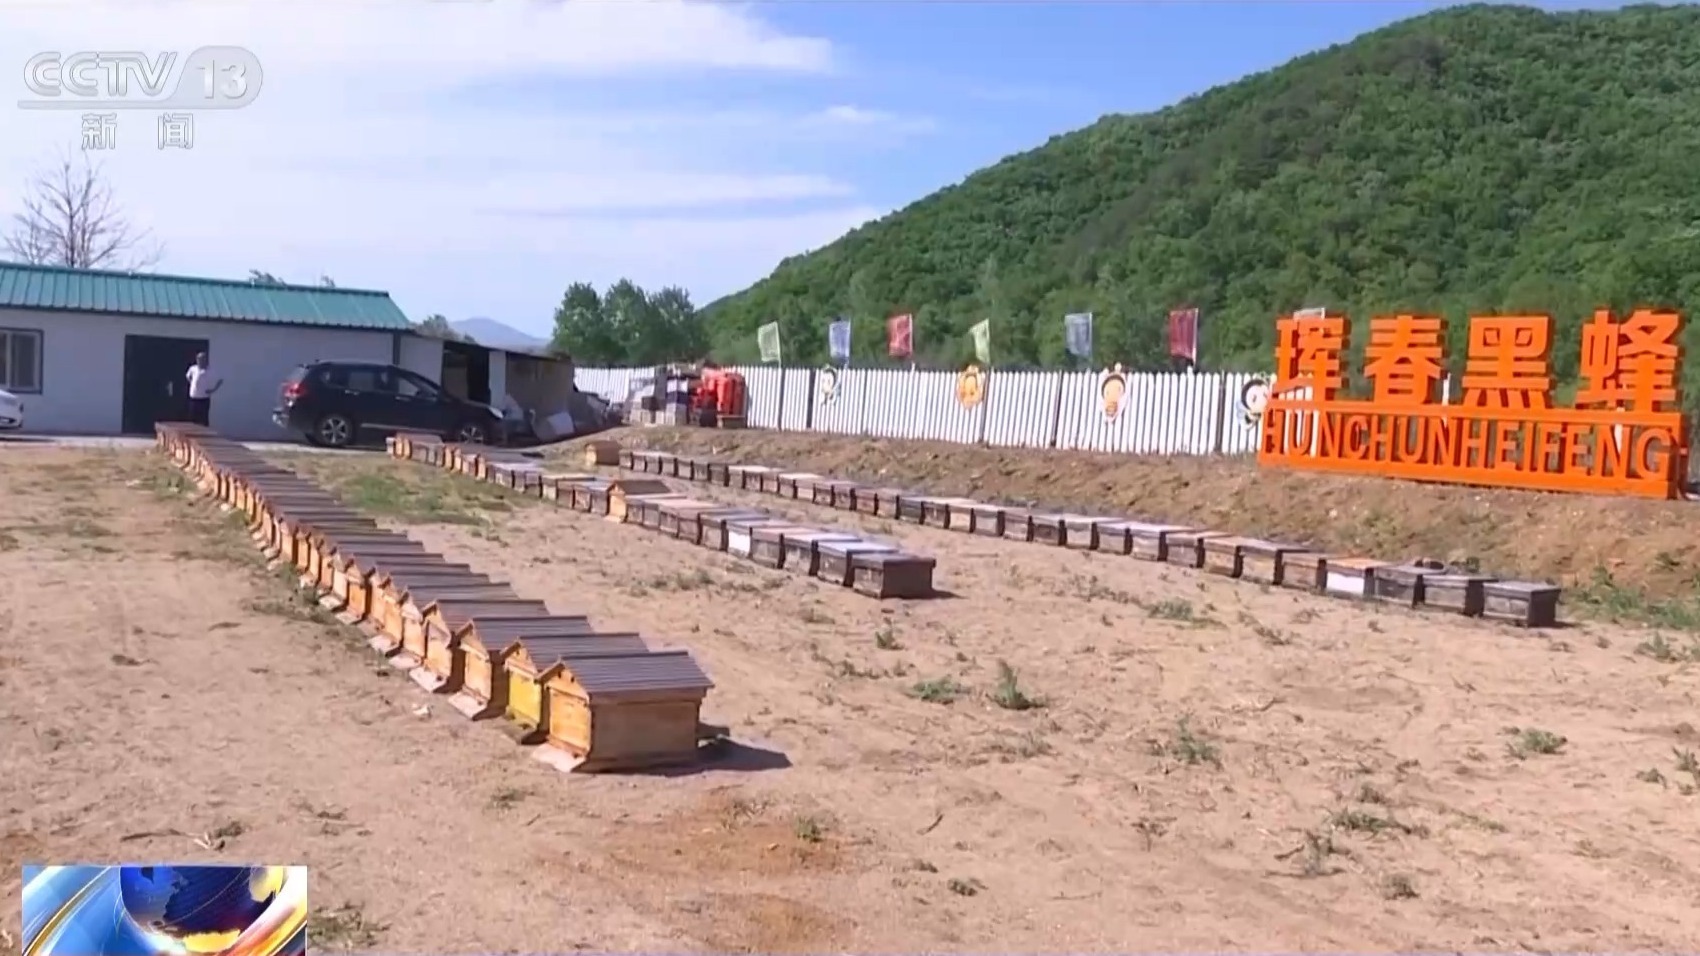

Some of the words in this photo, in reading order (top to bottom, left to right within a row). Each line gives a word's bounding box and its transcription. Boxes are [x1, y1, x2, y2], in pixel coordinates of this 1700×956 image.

[1272, 309, 1682, 412] 珲春黑蜂
[1261, 408, 1672, 480] HUNCHUNHEIFENG
